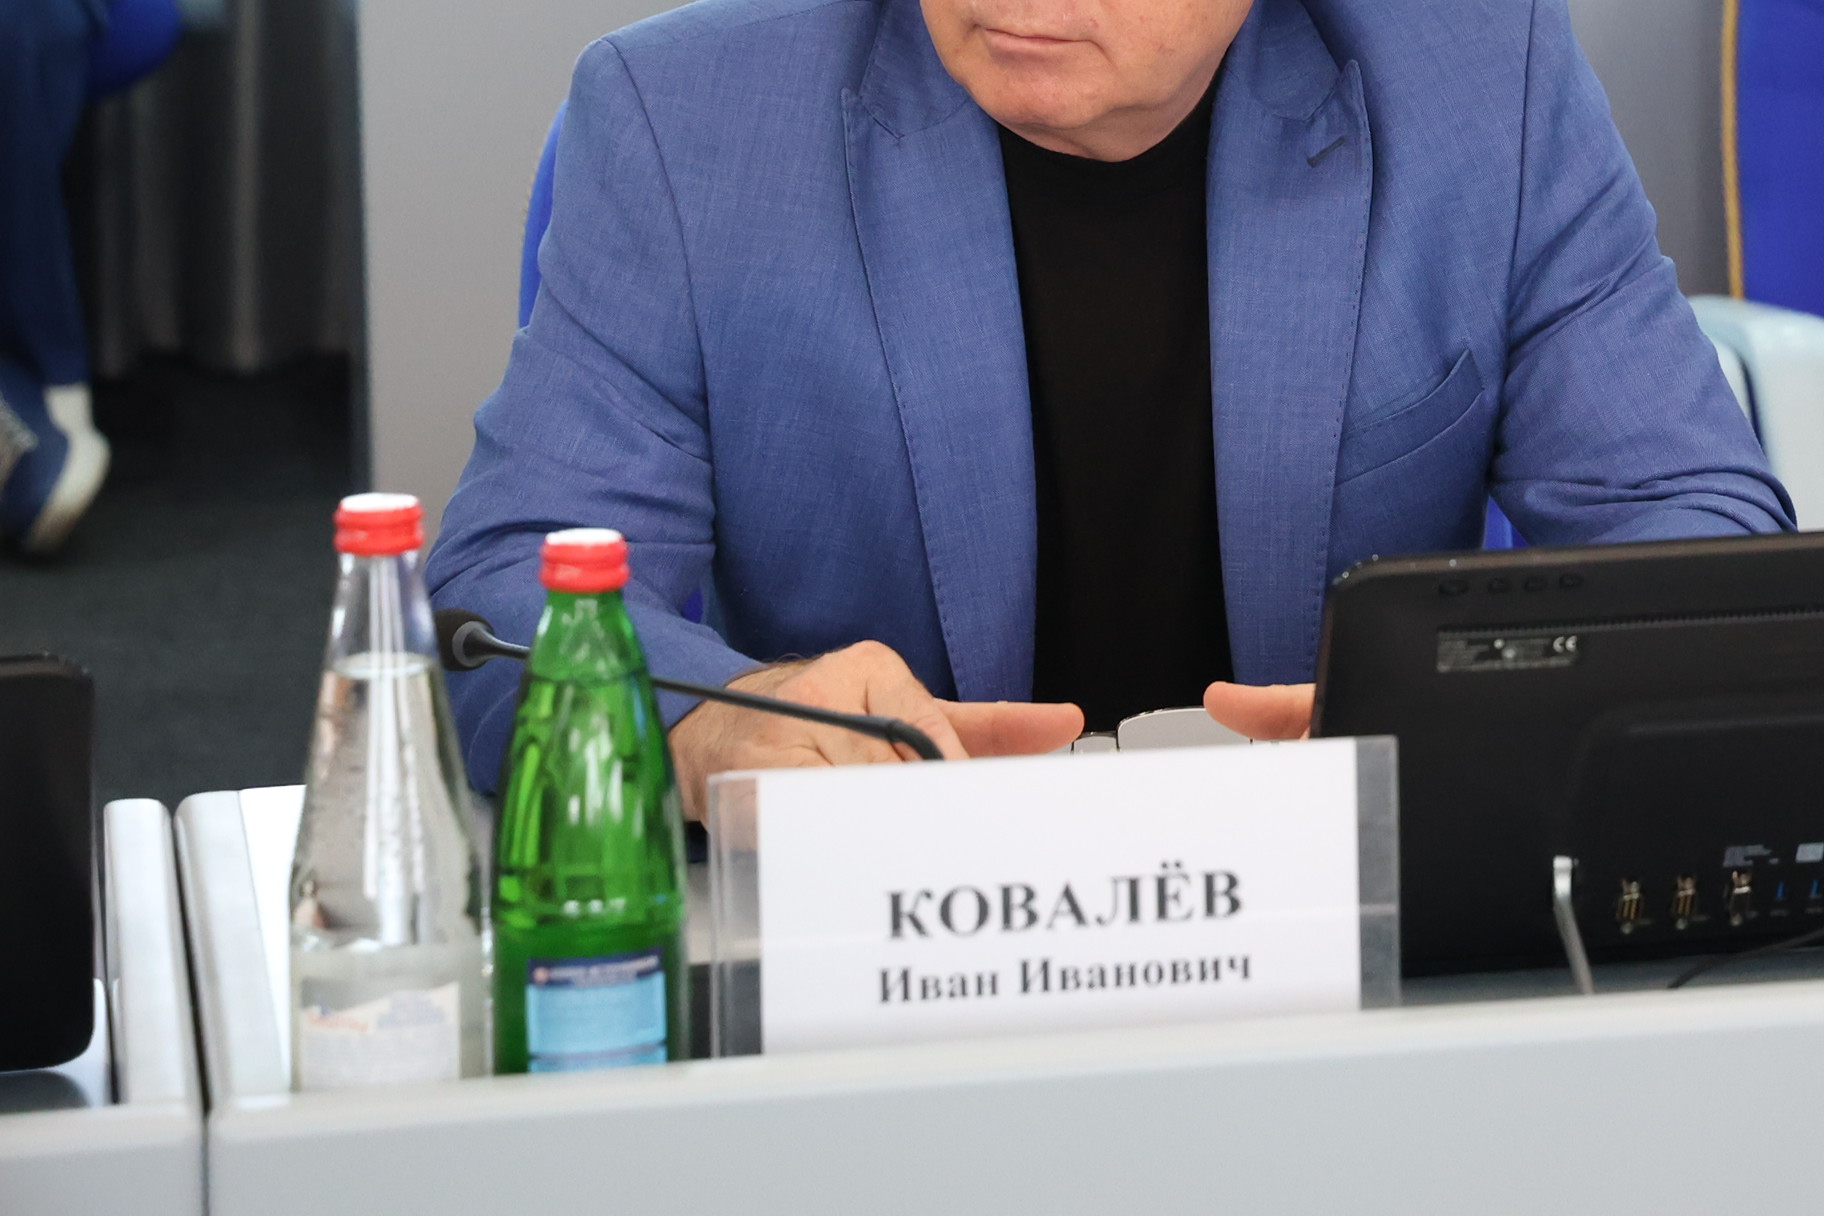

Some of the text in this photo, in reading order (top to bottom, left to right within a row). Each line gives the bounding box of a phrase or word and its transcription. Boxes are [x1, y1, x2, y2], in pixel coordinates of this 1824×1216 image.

[886, 859, 1244, 940] КОВАЛЁВ
[878, 954, 1252, 1004] Иван Иванович
